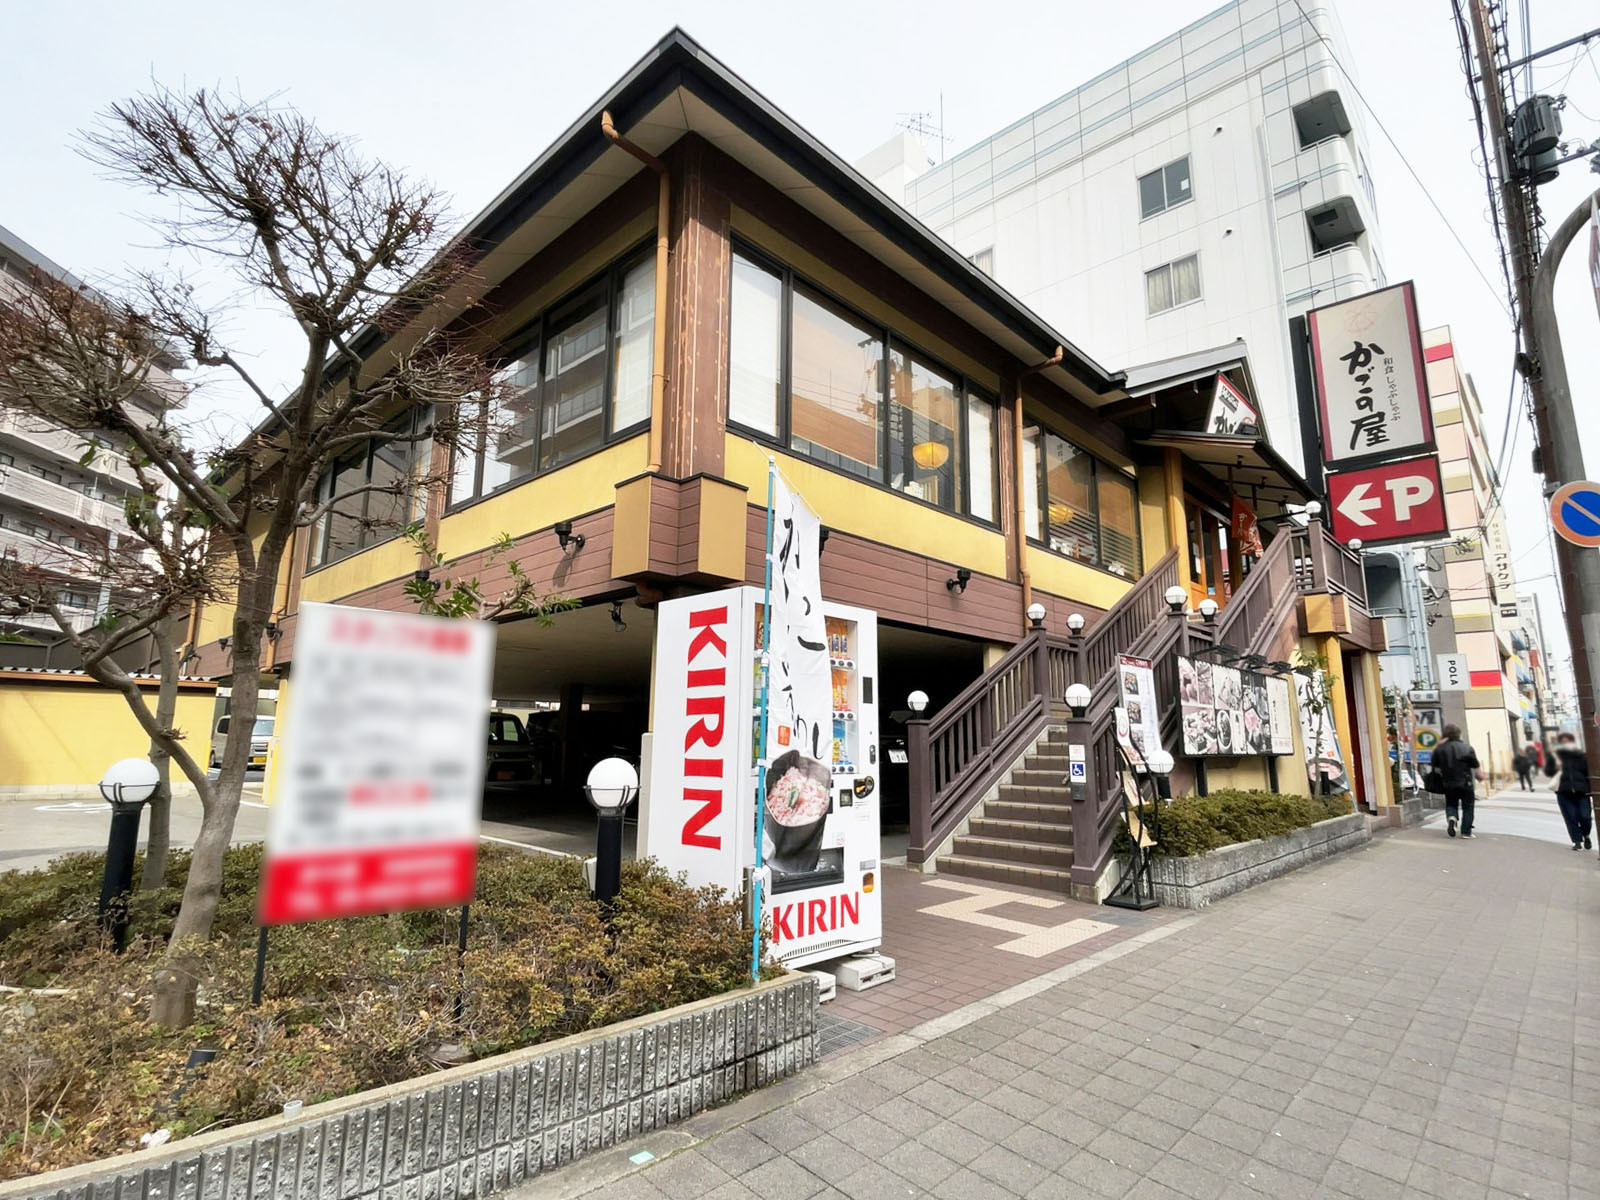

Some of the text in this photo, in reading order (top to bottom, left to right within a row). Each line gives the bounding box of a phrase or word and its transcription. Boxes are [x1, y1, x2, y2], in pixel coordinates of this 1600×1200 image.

[1339, 341, 1390, 451] かごの屋
[1385, 475, 1434, 522] P
[1447, 660, 1459, 686] POLA
[681, 605, 728, 851] KIRIN
[1422, 733, 1435, 747] P
[772, 891, 860, 944] KIRIN
